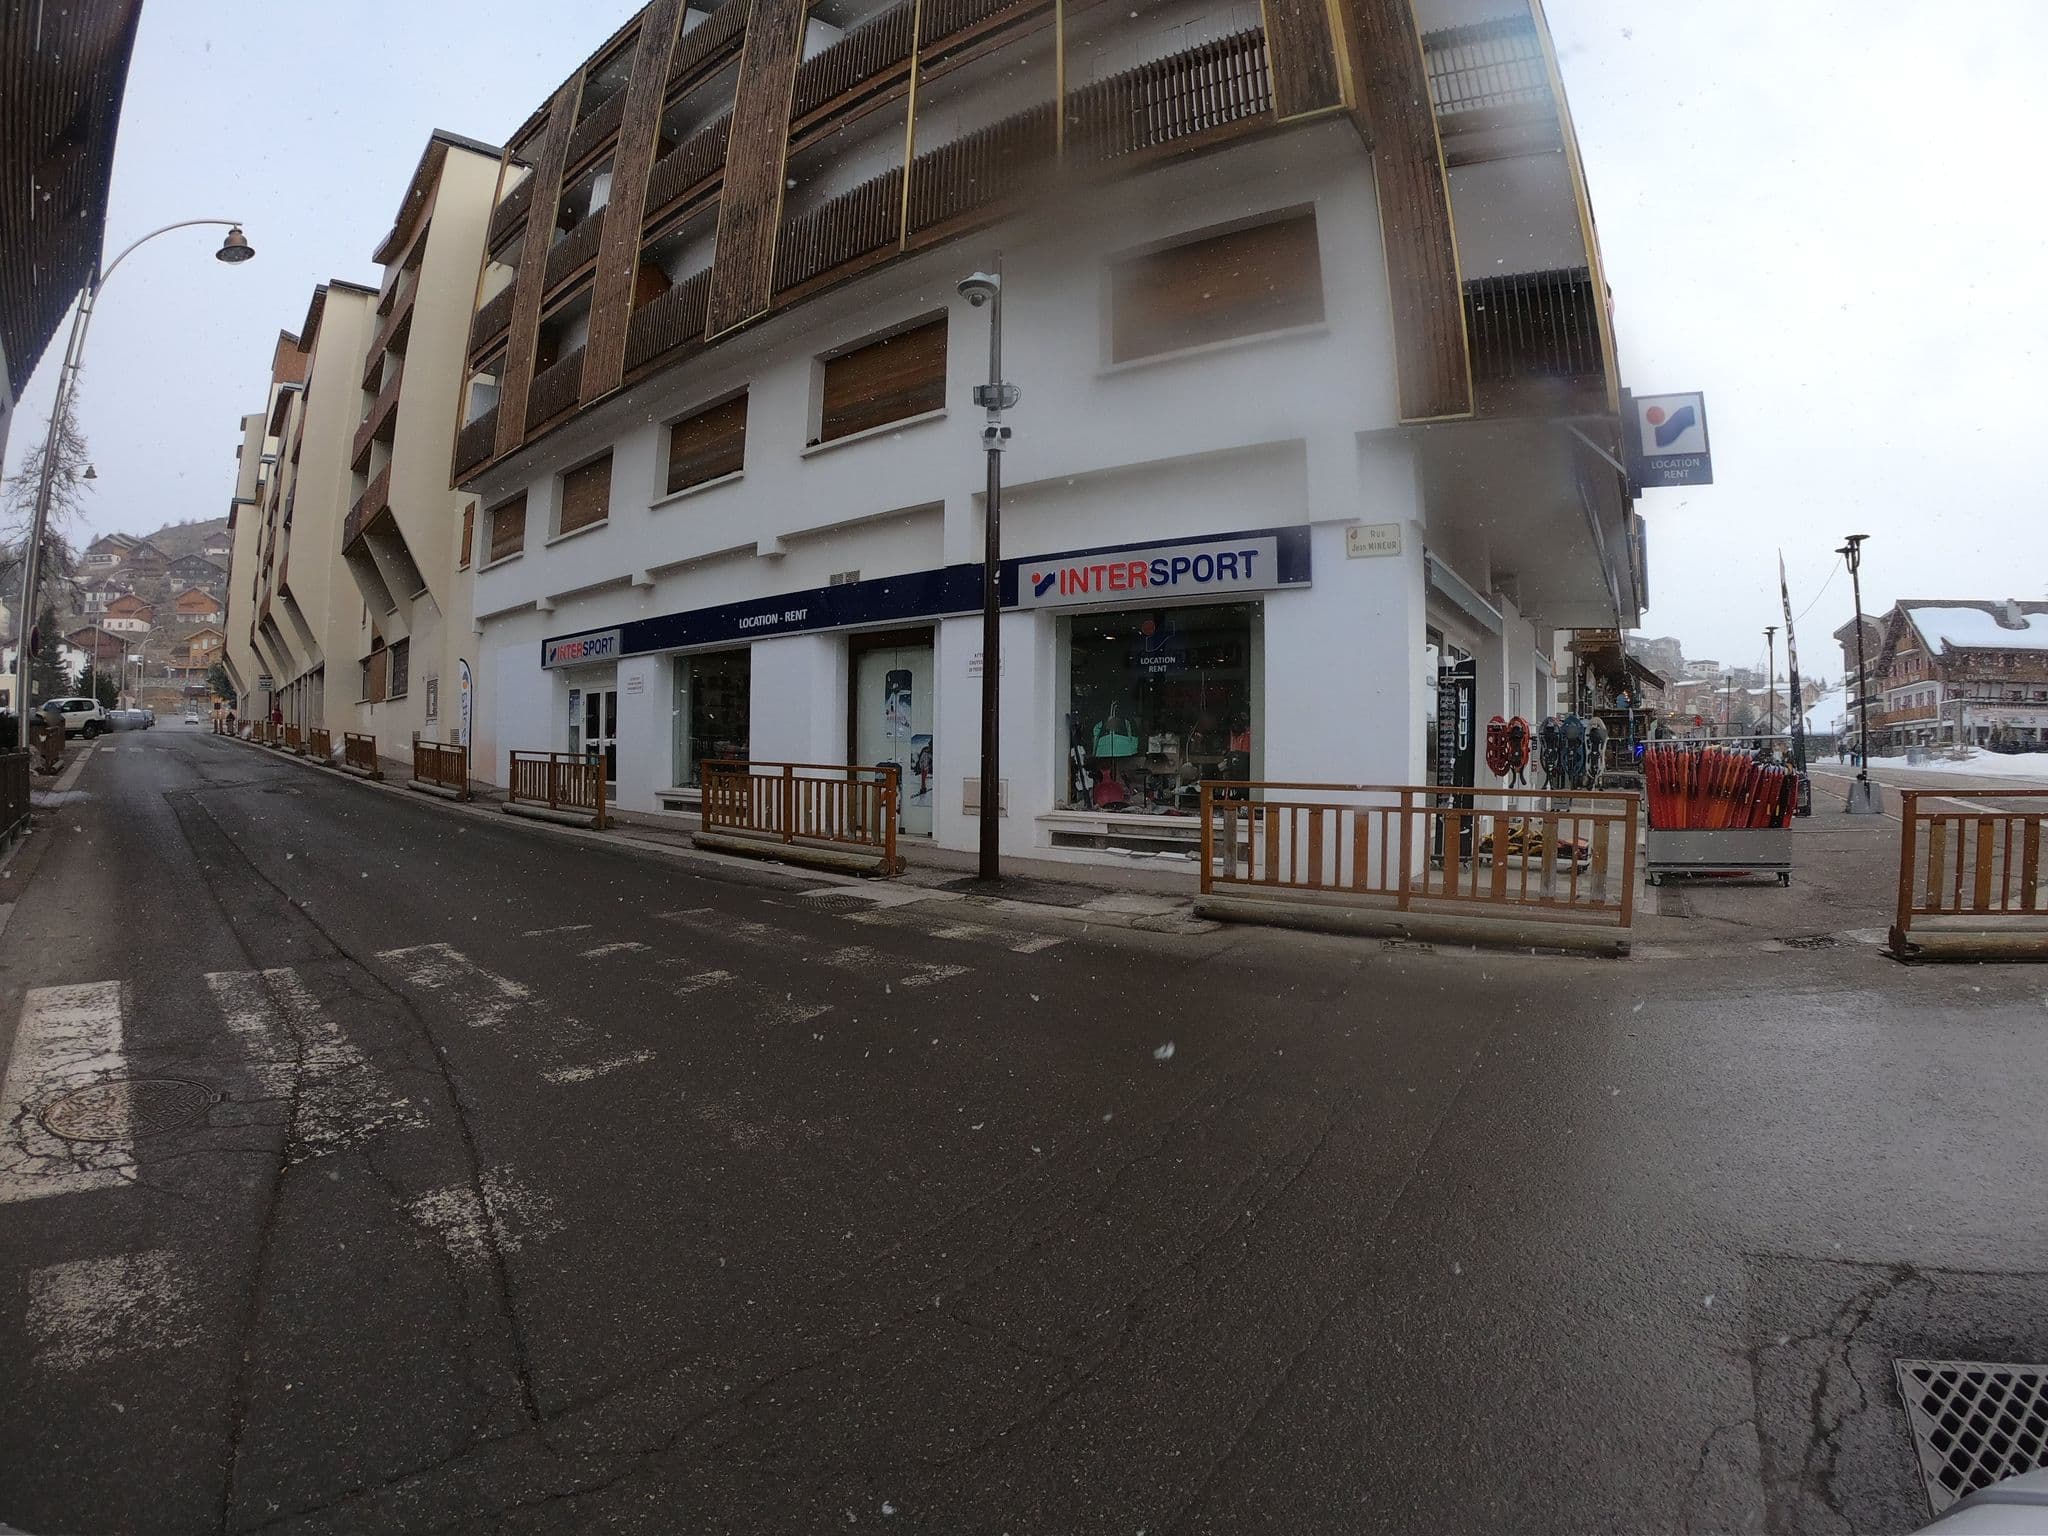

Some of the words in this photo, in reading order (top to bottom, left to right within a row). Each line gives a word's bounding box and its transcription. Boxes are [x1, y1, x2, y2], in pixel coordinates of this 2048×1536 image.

[1651, 457, 1700, 470] LOCATION
[1664, 469, 1689, 479] RENT
[1368, 541, 1397, 551] MINEUR
[1060, 550, 1259, 596] INTERSPORT
[739, 614, 778, 628] LOCATION
[784, 609, 808, 621] RENT
[557, 636, 614, 662] INTERSPORT
[1140, 656, 1176, 665] LOCATION
[1148, 665, 1168, 673] RENT
